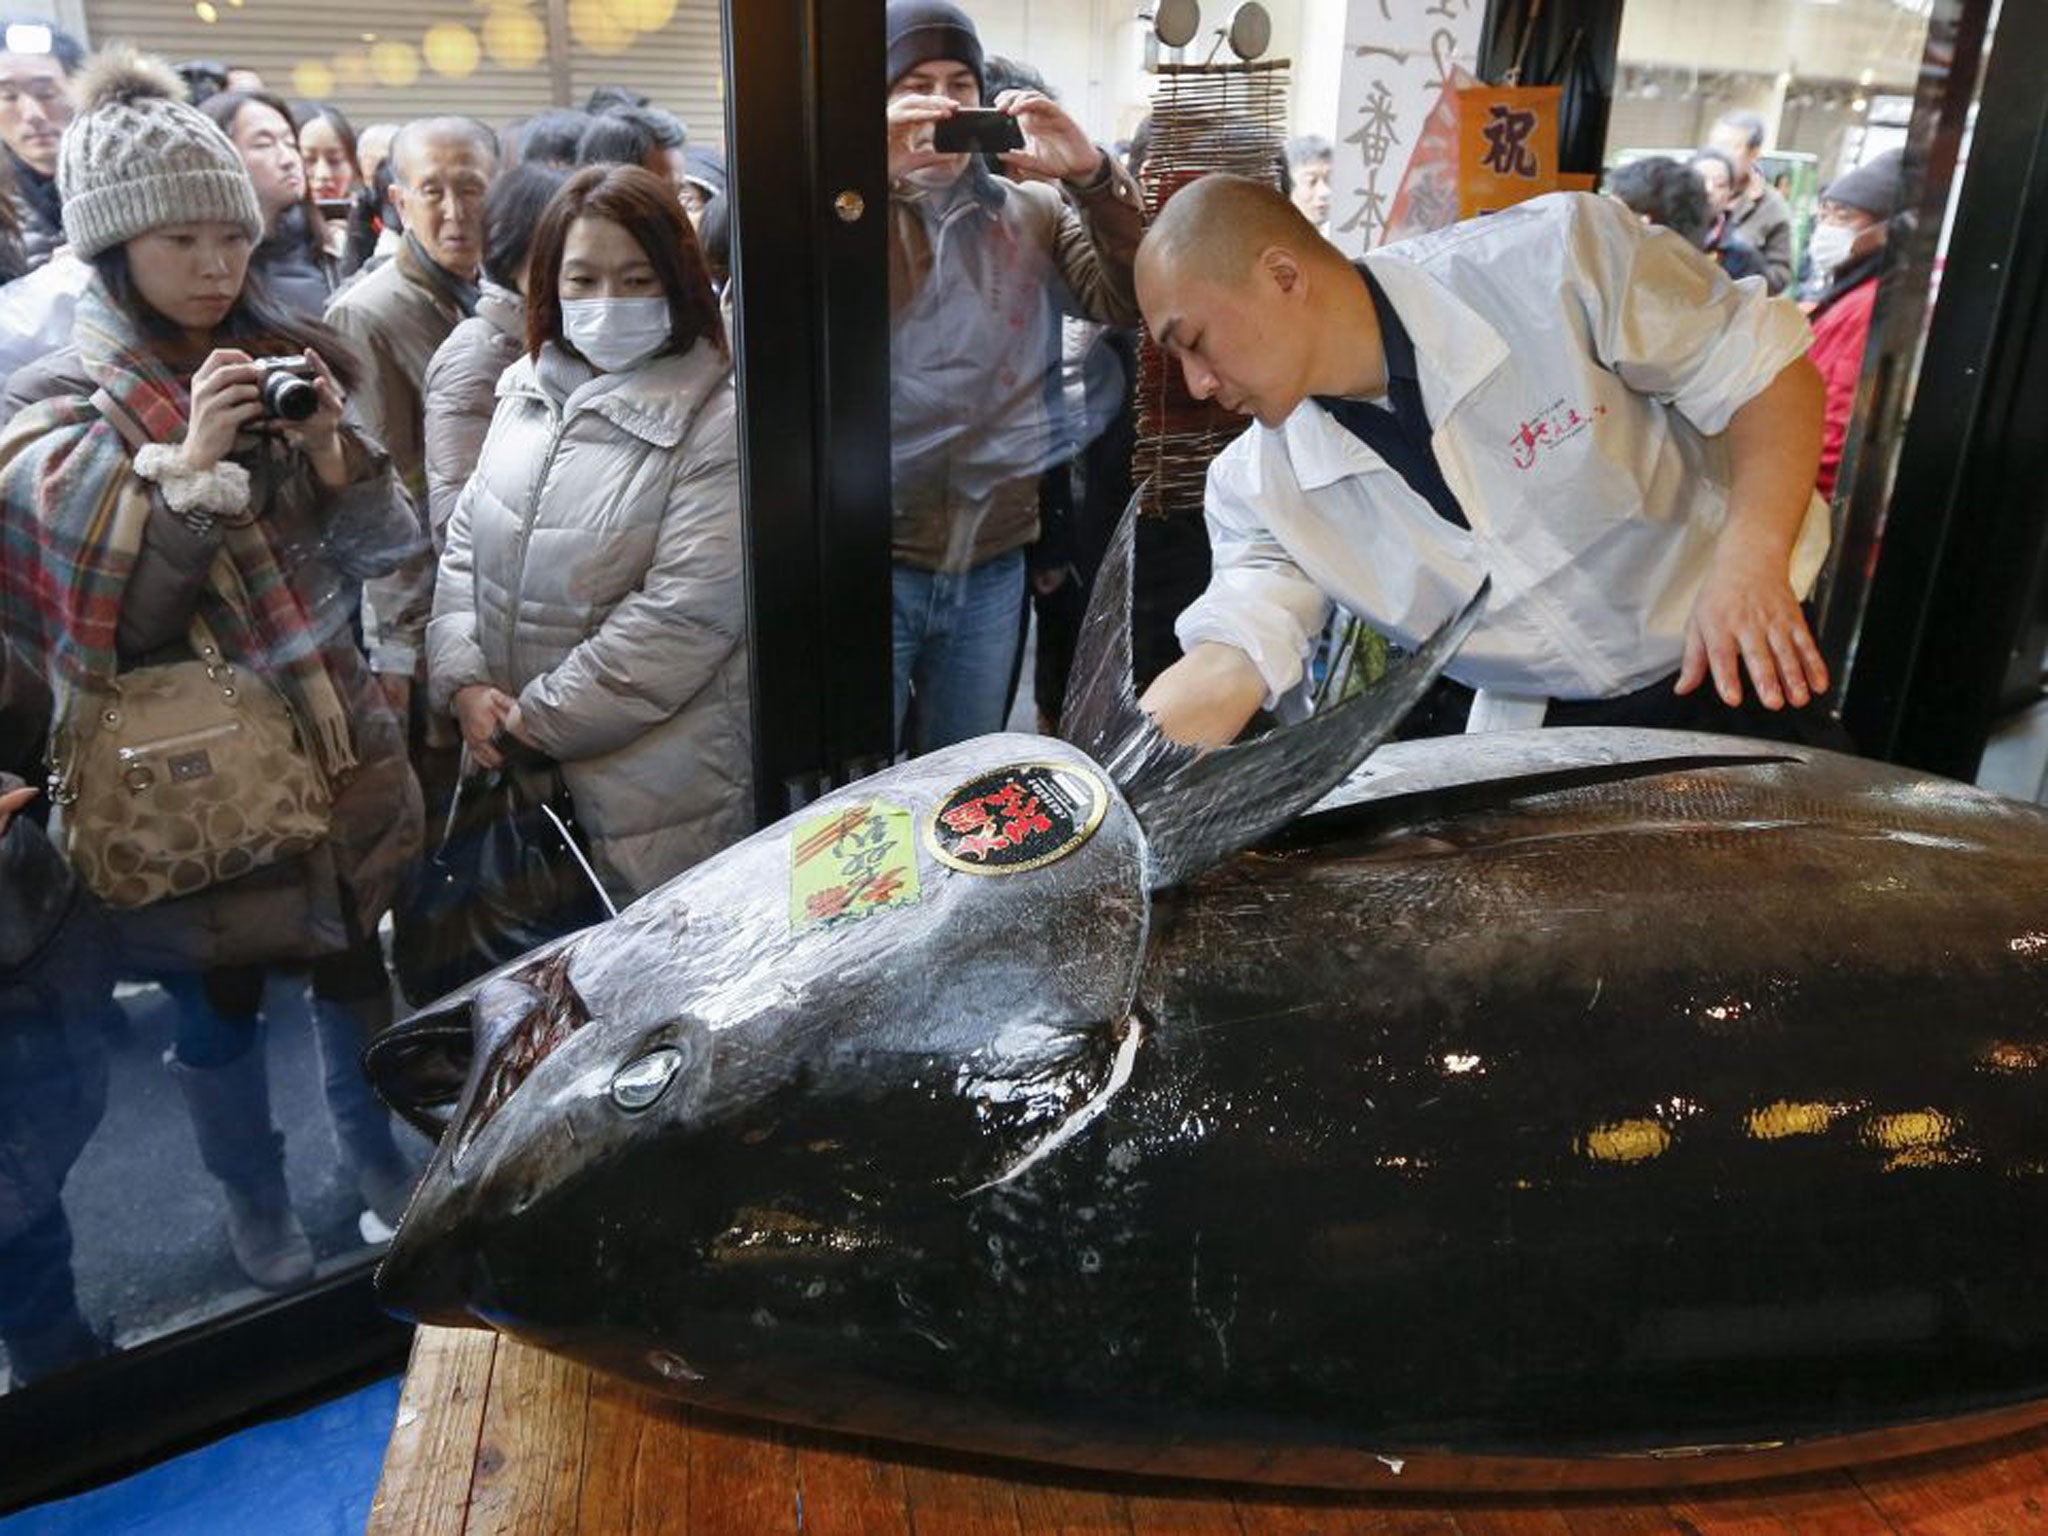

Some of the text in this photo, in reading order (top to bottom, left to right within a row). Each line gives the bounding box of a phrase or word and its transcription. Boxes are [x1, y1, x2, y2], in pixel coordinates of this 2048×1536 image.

[1337, 0, 1410, 252] 一番本
[1479, 104, 1538, 216] 祝
